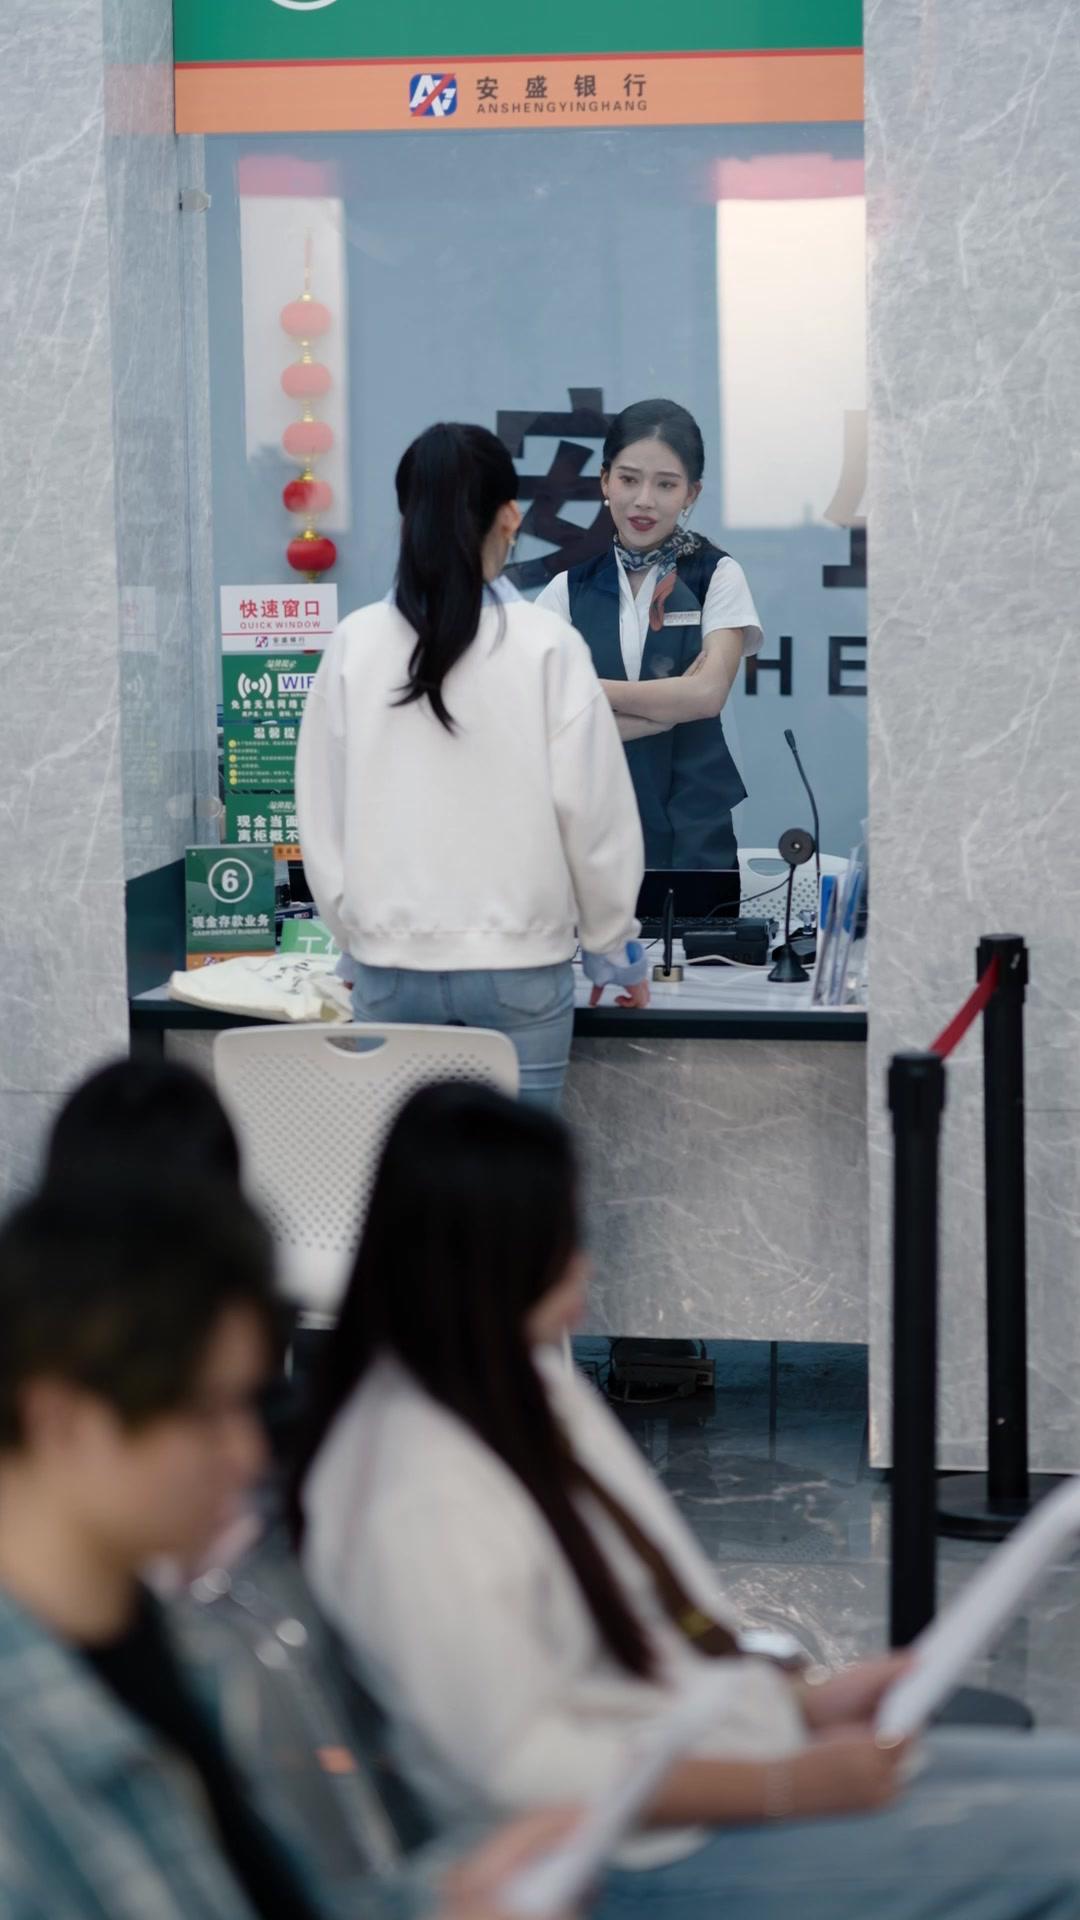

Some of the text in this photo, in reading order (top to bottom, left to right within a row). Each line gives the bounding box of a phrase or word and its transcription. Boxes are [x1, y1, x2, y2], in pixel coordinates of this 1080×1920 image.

[477, 73, 647, 99] 安盛银行
[477, 100, 647, 114] ANSHENGYINGHANG
[240, 599, 320, 618] 快速窗口
[240, 620, 320, 629] QUICK WINDOW
[237, 815, 299, 828] 现金当面
[221, 869, 239, 893] 6
[192, 913, 270, 929] 现金存款业务
